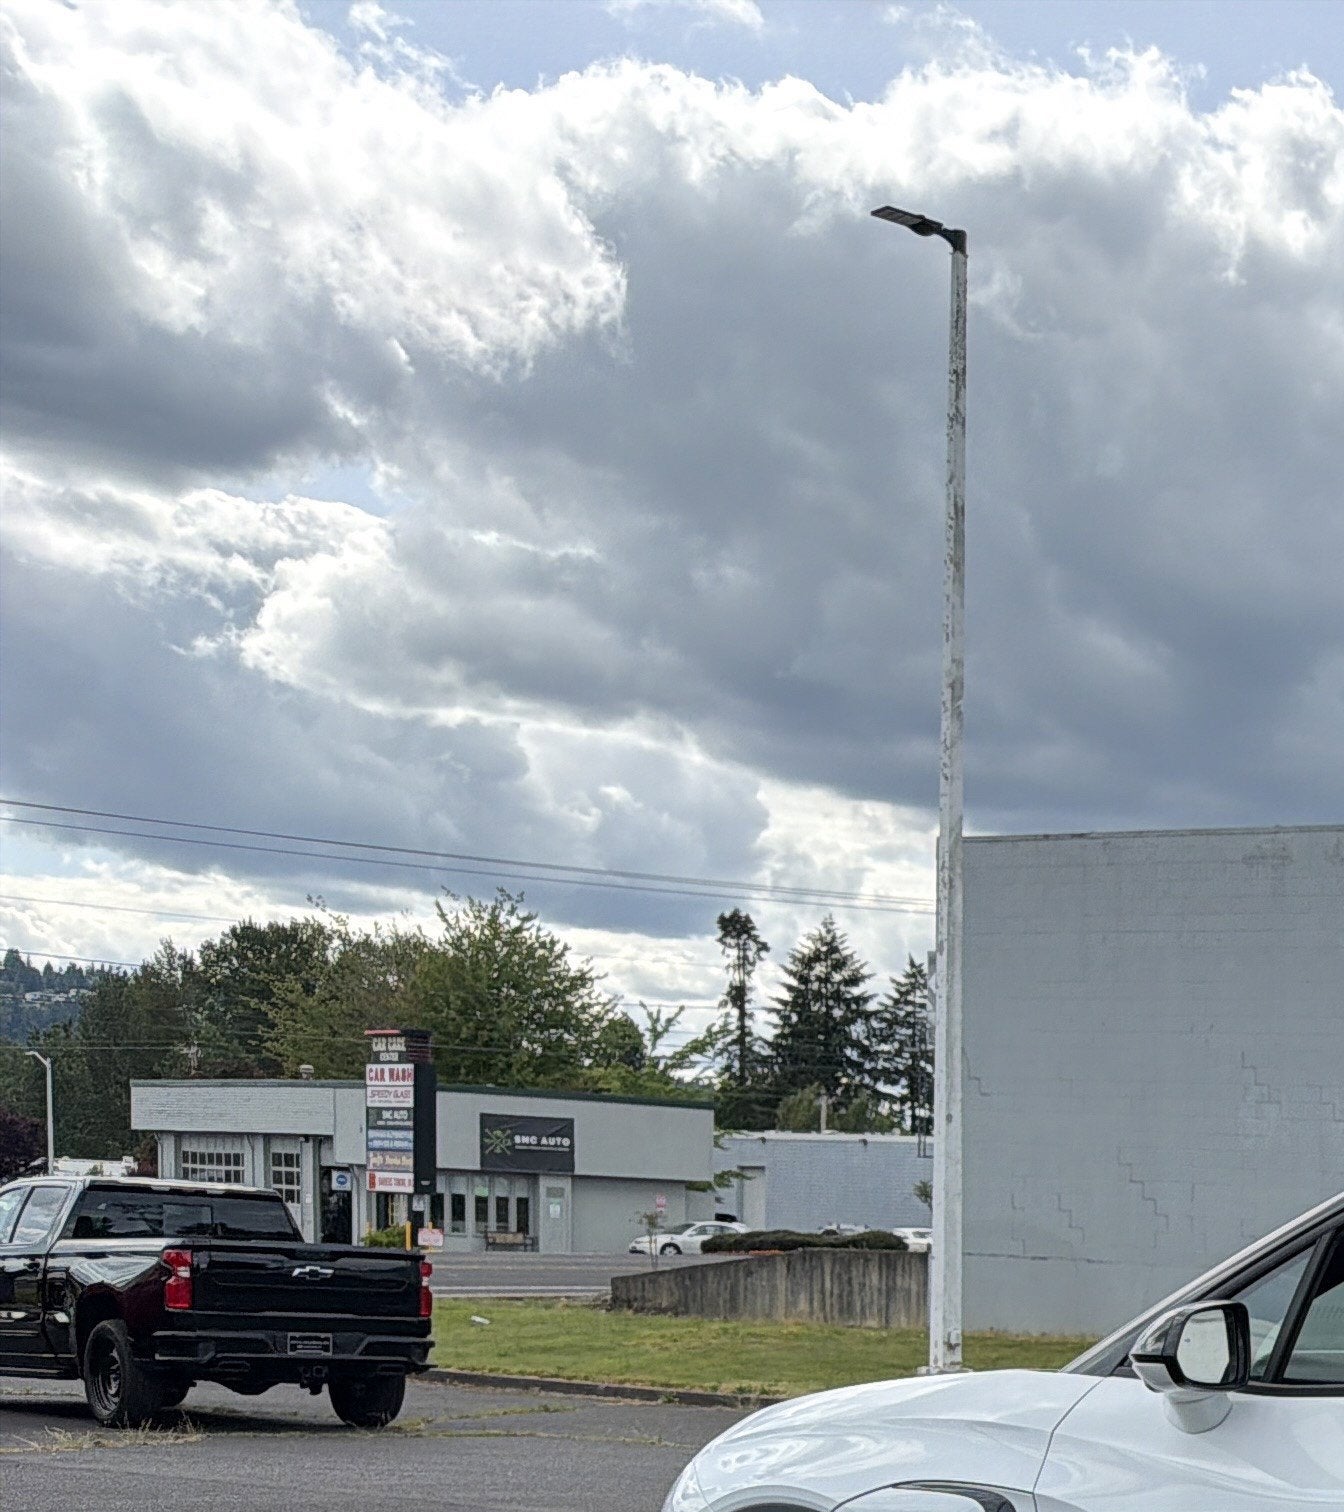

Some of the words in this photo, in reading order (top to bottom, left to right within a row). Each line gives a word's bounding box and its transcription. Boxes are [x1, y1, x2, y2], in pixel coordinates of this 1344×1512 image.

[368, 1067, 386, 1082] CAR
[388, 1068, 413, 1083] WASH
[540, 1136, 571, 1147] AUTO
